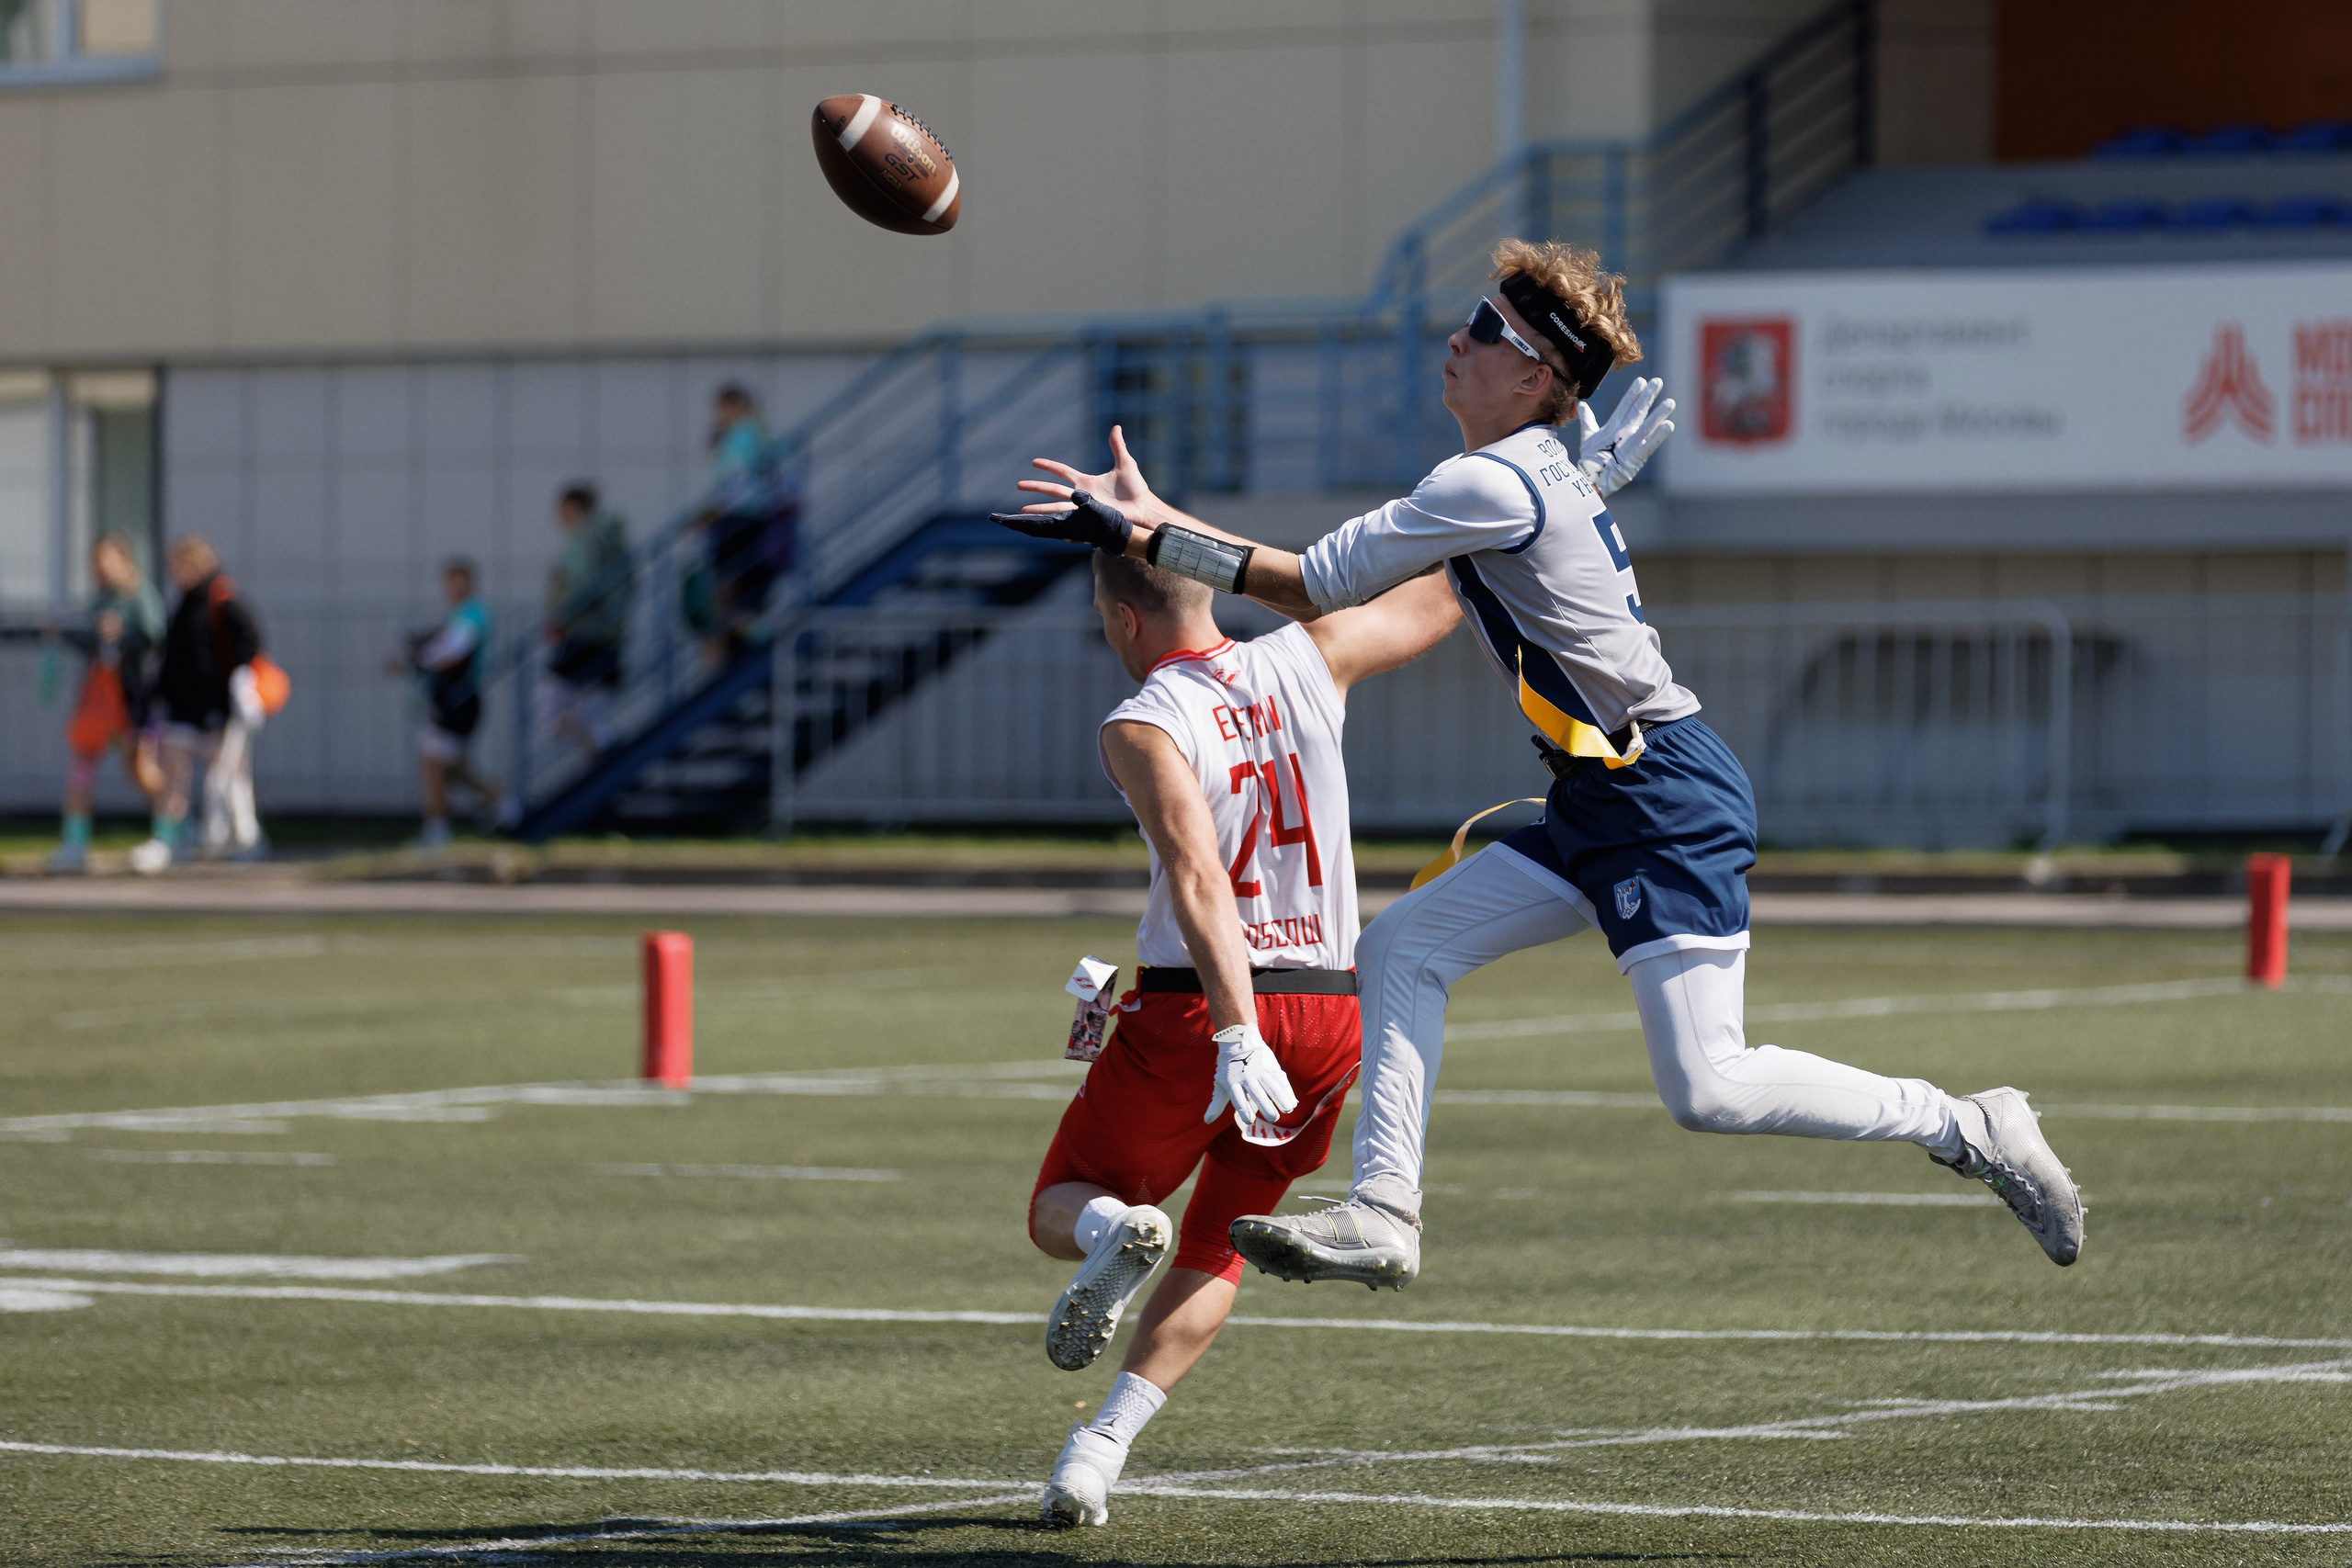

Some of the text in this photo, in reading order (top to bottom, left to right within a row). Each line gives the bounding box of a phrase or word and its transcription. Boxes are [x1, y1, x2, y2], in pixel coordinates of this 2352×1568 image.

[885, 152, 920, 182] GST
[890, 122, 936, 175] Wilson
[1228, 752, 1323, 898] 24
[1241, 913, 1322, 950] OSCOW
